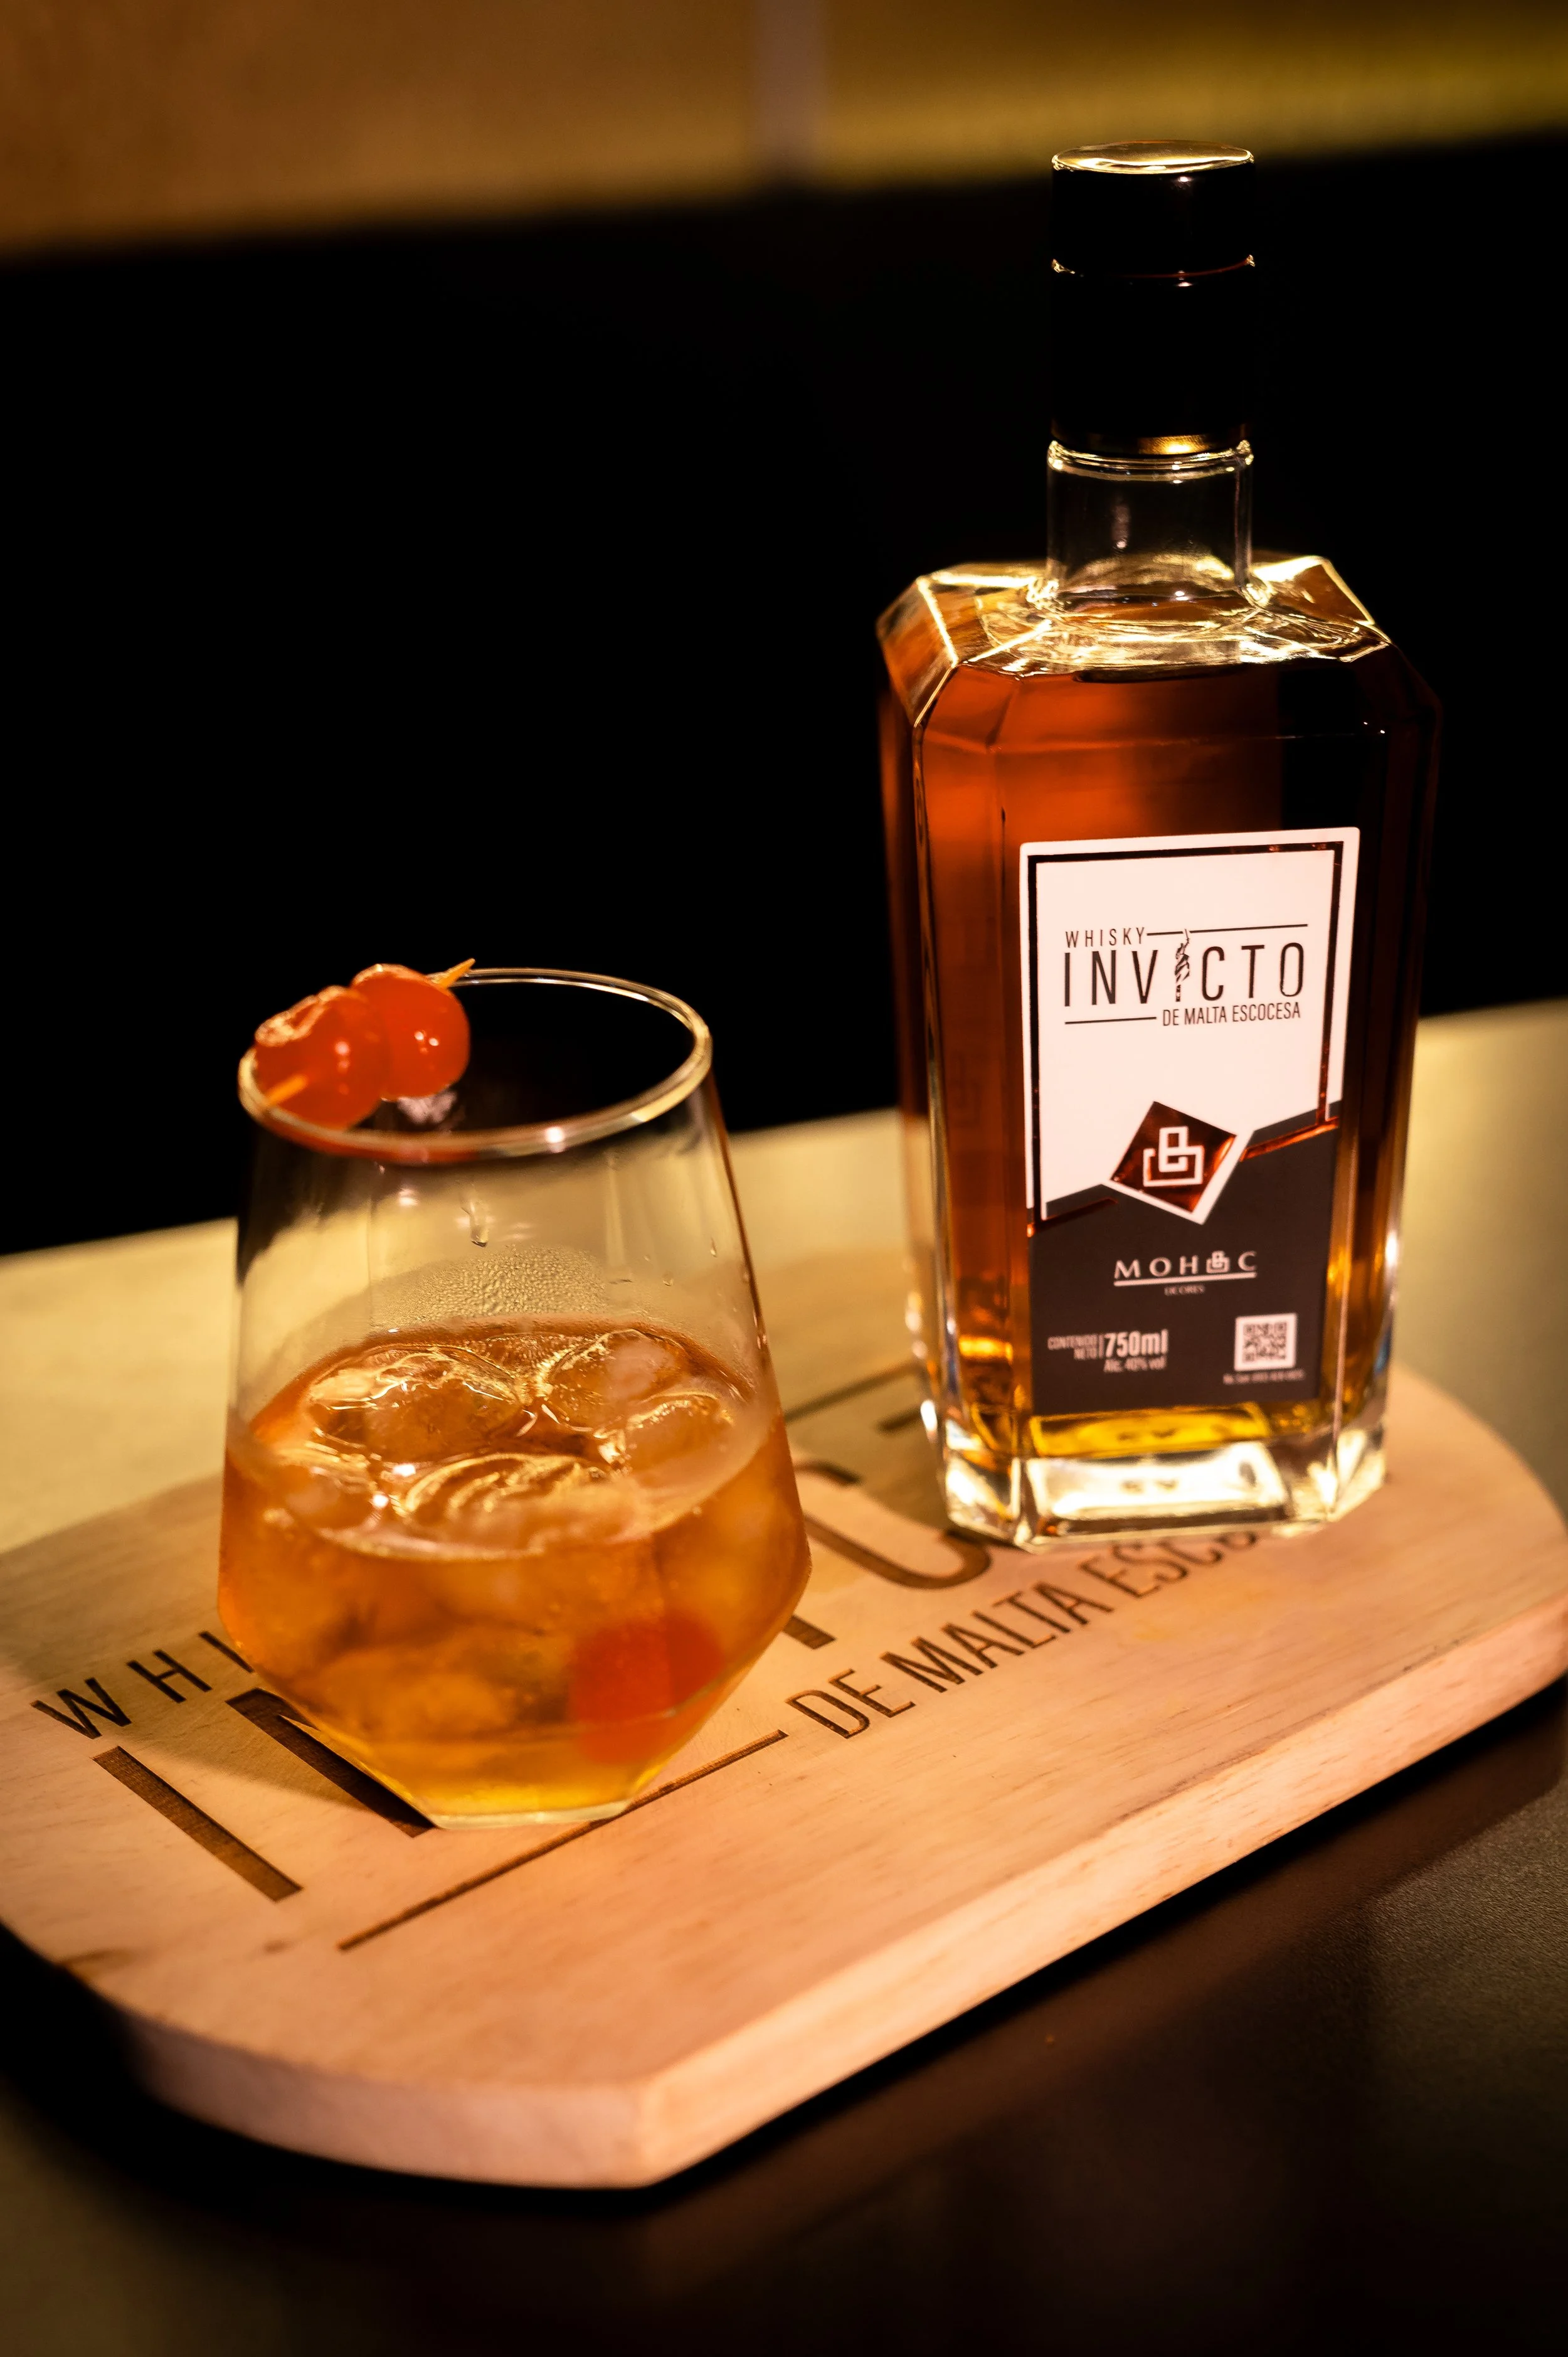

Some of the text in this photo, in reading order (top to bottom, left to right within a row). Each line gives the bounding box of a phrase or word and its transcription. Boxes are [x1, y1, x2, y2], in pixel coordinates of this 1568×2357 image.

[1066, 927, 1145, 948] WHISKY
[1064, 929, 1304, 1006] INVICTO
[1163, 1001, 1301, 1026] DE MALTA ESCOCESA
[1104, 1328, 1169, 1358] 750ml
[30, 1631, 255, 1740] WHI
[785, 1581, 1115, 1739] DE MALTA
